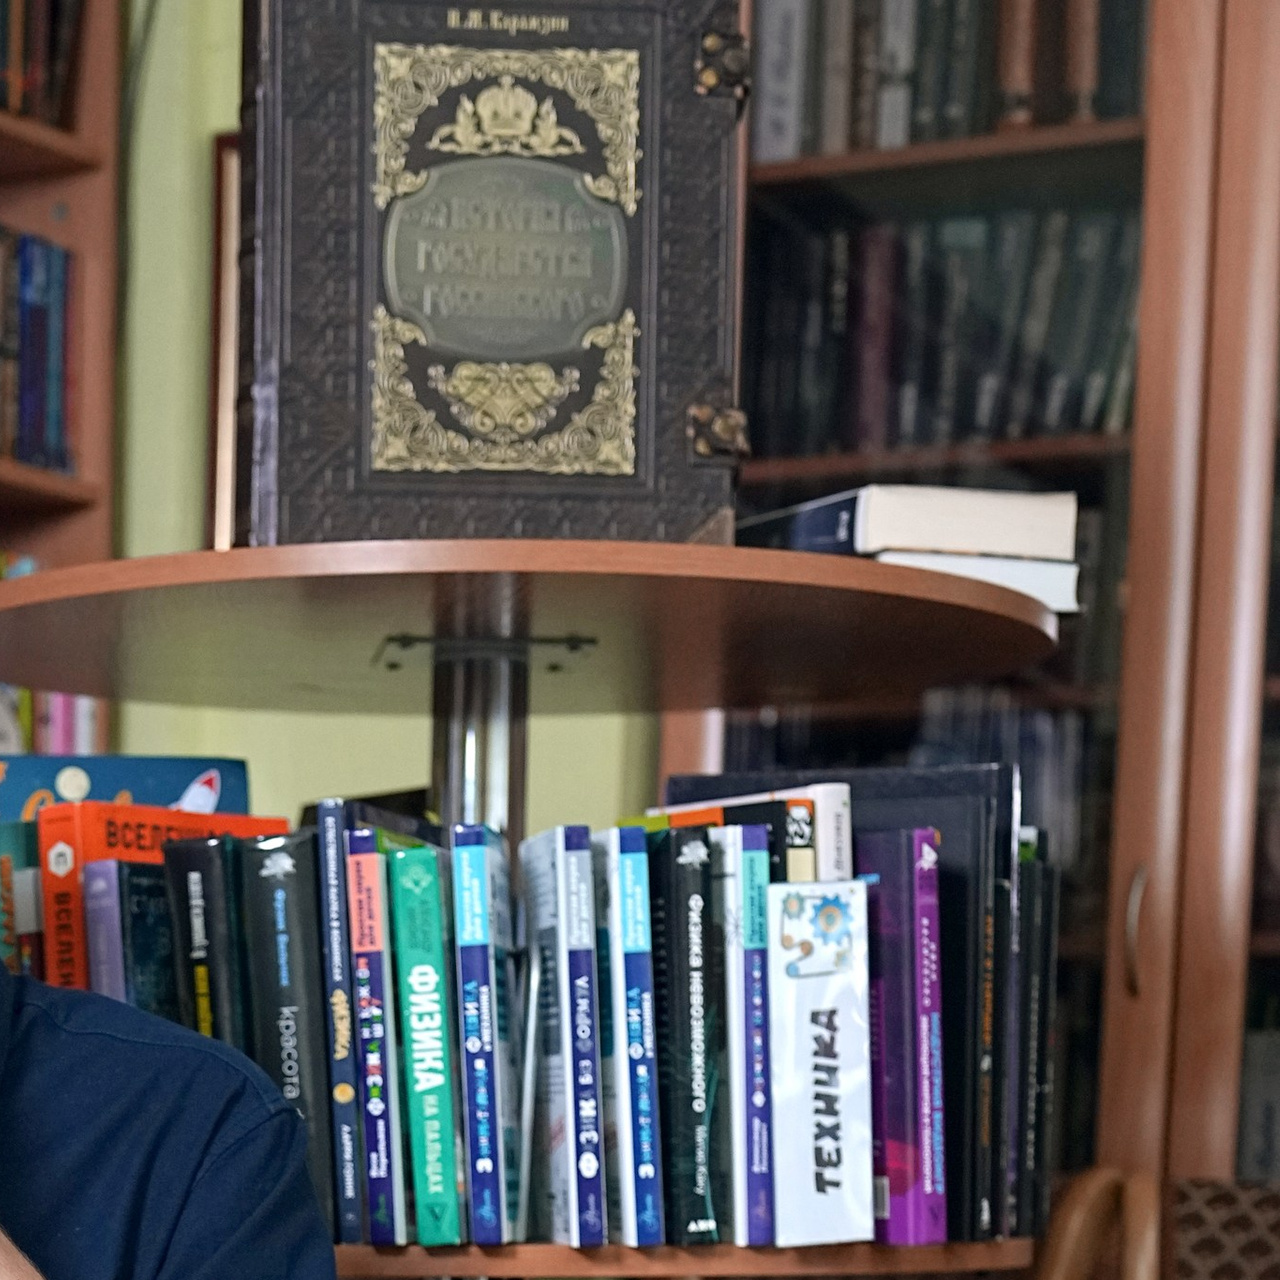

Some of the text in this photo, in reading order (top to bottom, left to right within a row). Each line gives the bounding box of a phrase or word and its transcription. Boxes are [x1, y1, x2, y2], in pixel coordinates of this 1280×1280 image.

[53, 890, 76, 987] ВСЕЛЕН
[688, 894, 707, 1113] Физика невозможного
[276, 1005, 301, 1100] красота
[408, 964, 445, 1194] ФИЗИКА НА ПАЛЬЦАХ
[810, 1008, 842, 1195] ТЕХНИКА
